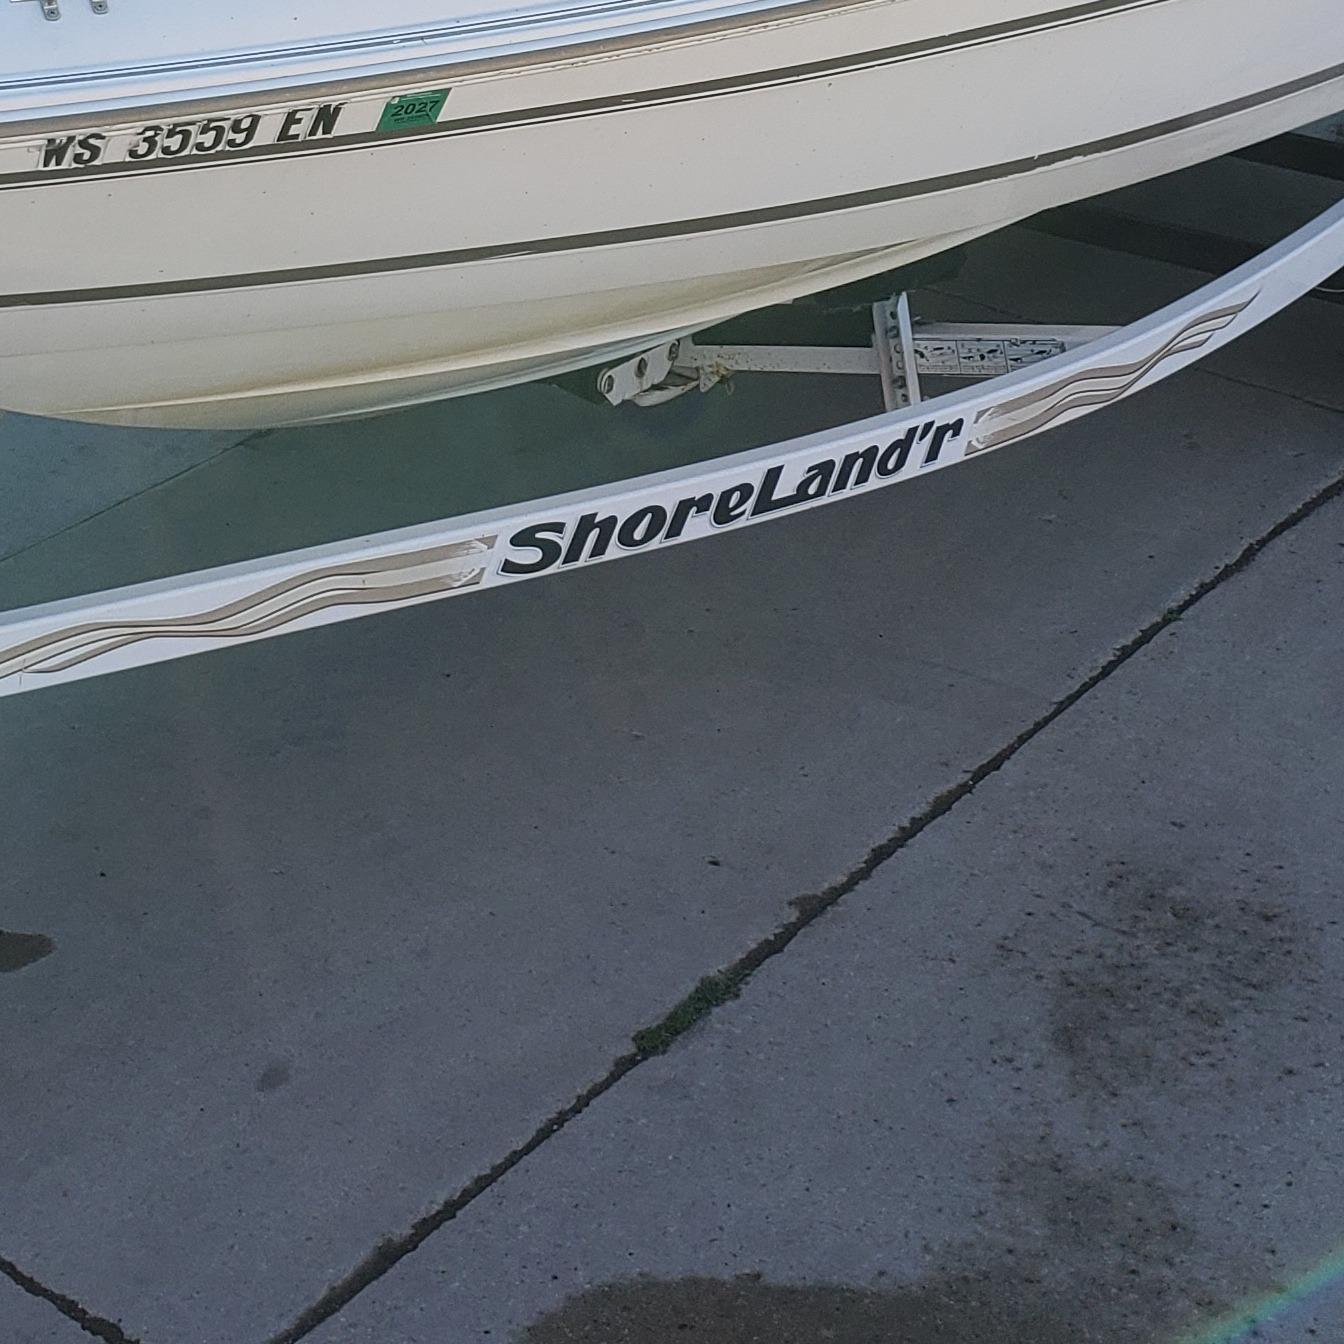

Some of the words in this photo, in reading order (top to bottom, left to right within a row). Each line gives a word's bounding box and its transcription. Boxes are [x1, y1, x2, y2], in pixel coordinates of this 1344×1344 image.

[42, 132, 106, 168] WS
[128, 113, 261, 160] 3559
[276, 102, 348, 143] EN
[390, 99, 440, 118] 2027
[500, 416, 965, 576] ShoreLand'r
